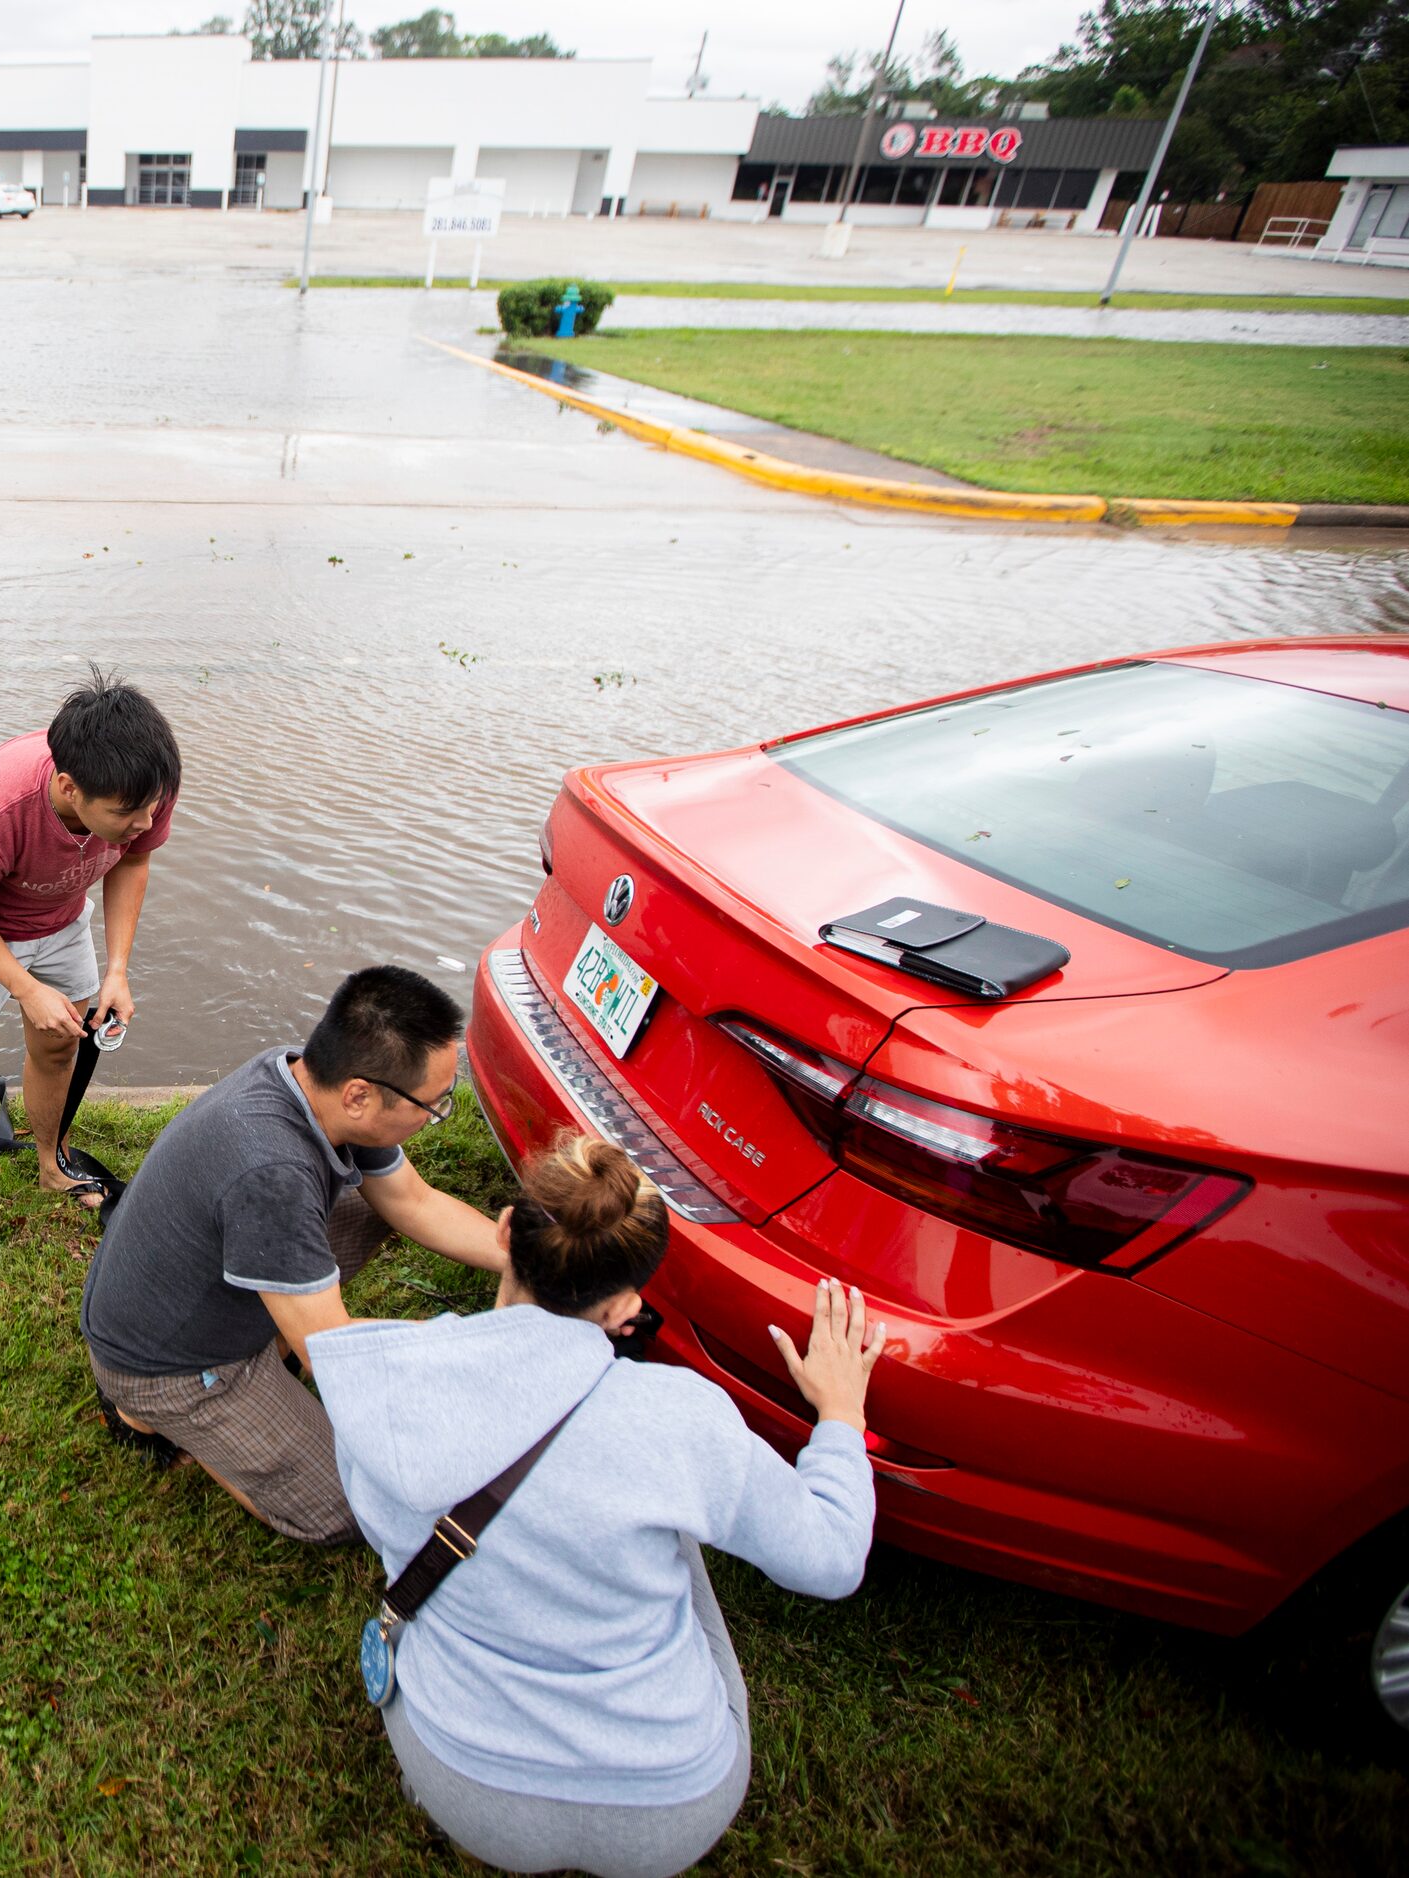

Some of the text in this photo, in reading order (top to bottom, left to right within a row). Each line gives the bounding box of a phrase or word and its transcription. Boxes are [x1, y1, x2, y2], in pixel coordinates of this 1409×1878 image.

[914, 126, 1023, 164] BBQ
[60, 856, 96, 880] THE
[577, 946, 608, 995] 42B
[597, 1014, 612, 1036] STATE
[697, 1101, 766, 1167] RICK CASE
